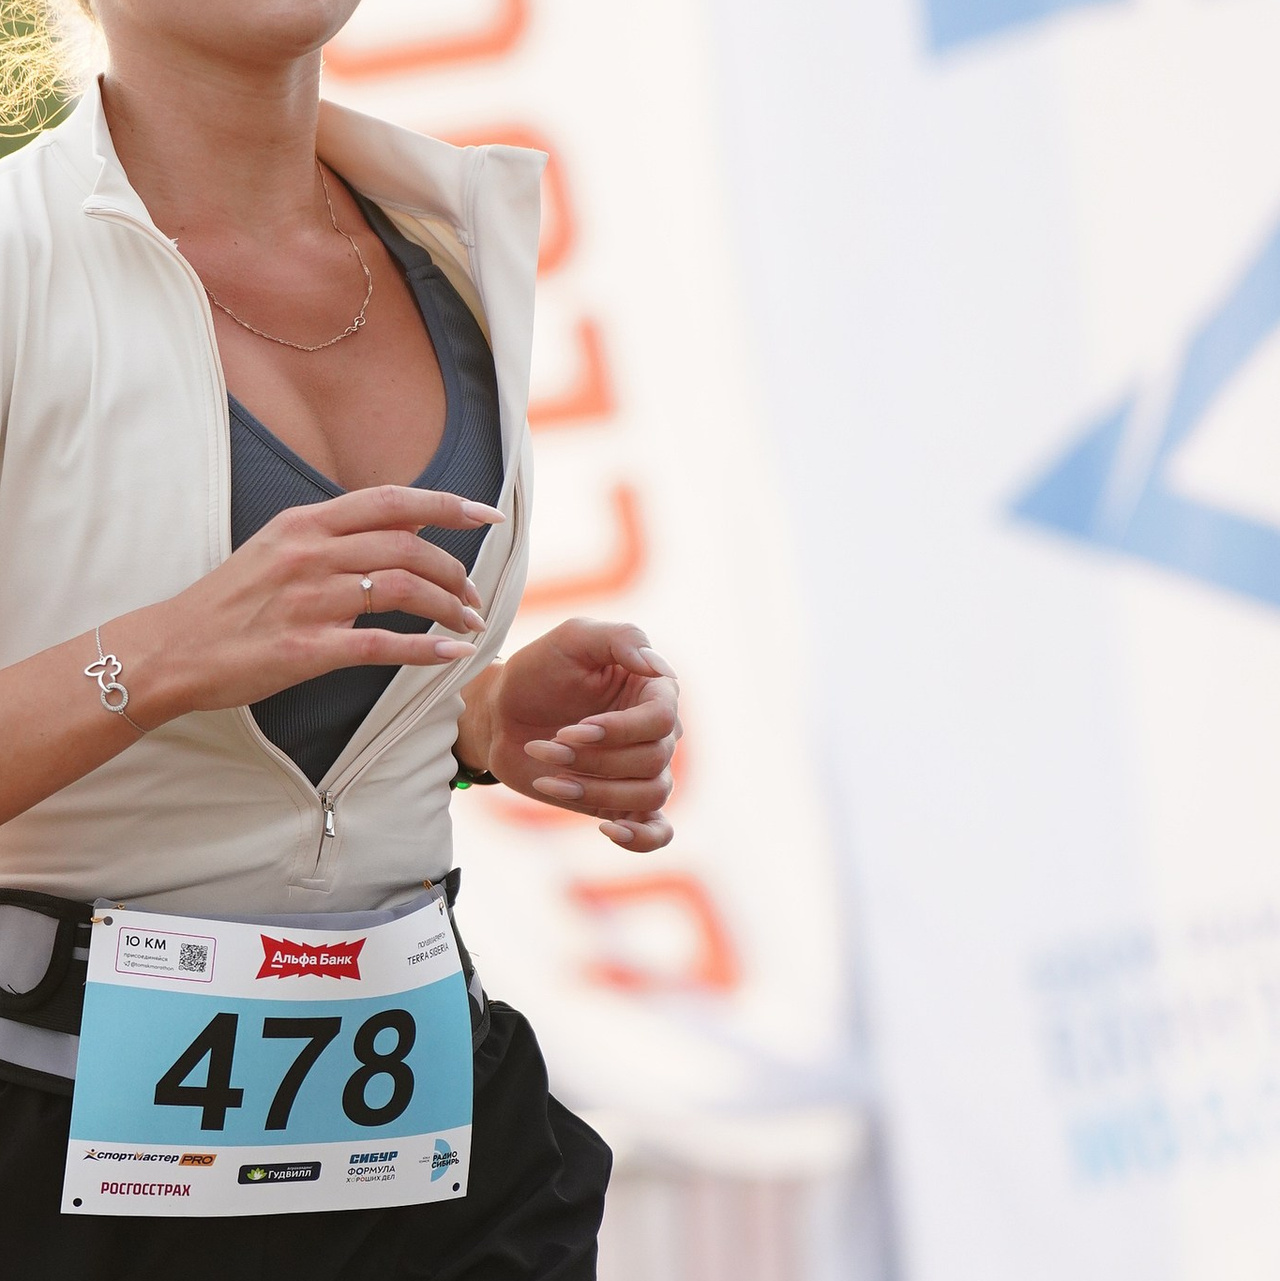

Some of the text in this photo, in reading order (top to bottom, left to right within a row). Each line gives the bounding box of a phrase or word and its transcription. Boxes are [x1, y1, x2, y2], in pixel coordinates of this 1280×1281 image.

[125, 935, 140, 947] 10
[271, 951, 352, 968] Альфа Банк
[407, 951, 429, 966] TERRA
[154, 1009, 417, 1132] 478
[181, 1154, 213, 1165] PRO
[349, 1151, 398, 1164] СИБУР
[433, 1151, 458, 1161] РАДИО
[431, 1158, 460, 1168] СИБИРЬ
[347, 1165, 395, 1175] ФОРМУЛА
[100, 1182, 191, 1196] РОСГОССТРАХ
